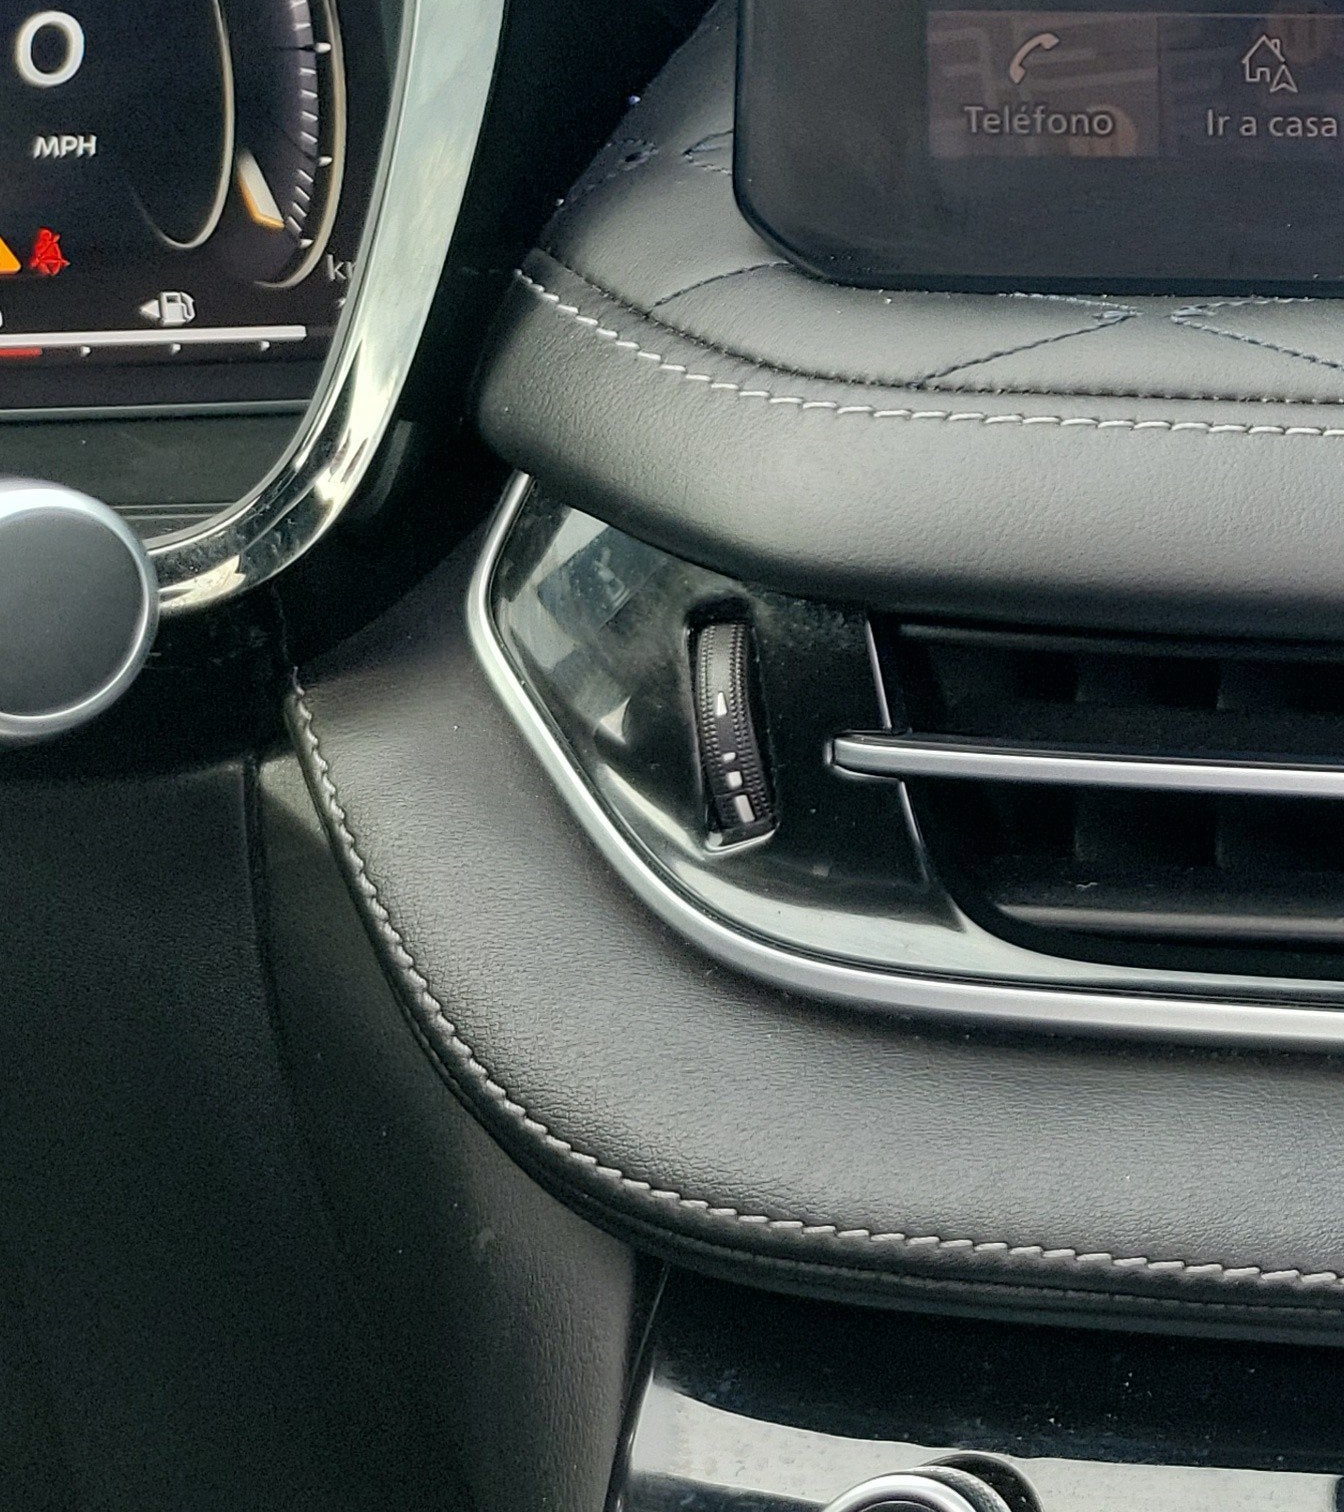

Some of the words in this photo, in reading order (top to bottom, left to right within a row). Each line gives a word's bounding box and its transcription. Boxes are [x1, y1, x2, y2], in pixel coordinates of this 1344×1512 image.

[964, 105, 1115, 136] Teléfono
[1207, 109, 1230, 136] Ir
[1239, 116, 1257, 136] a
[1267, 115, 1338, 138] casa
[33, 134, 97, 160] MPH
